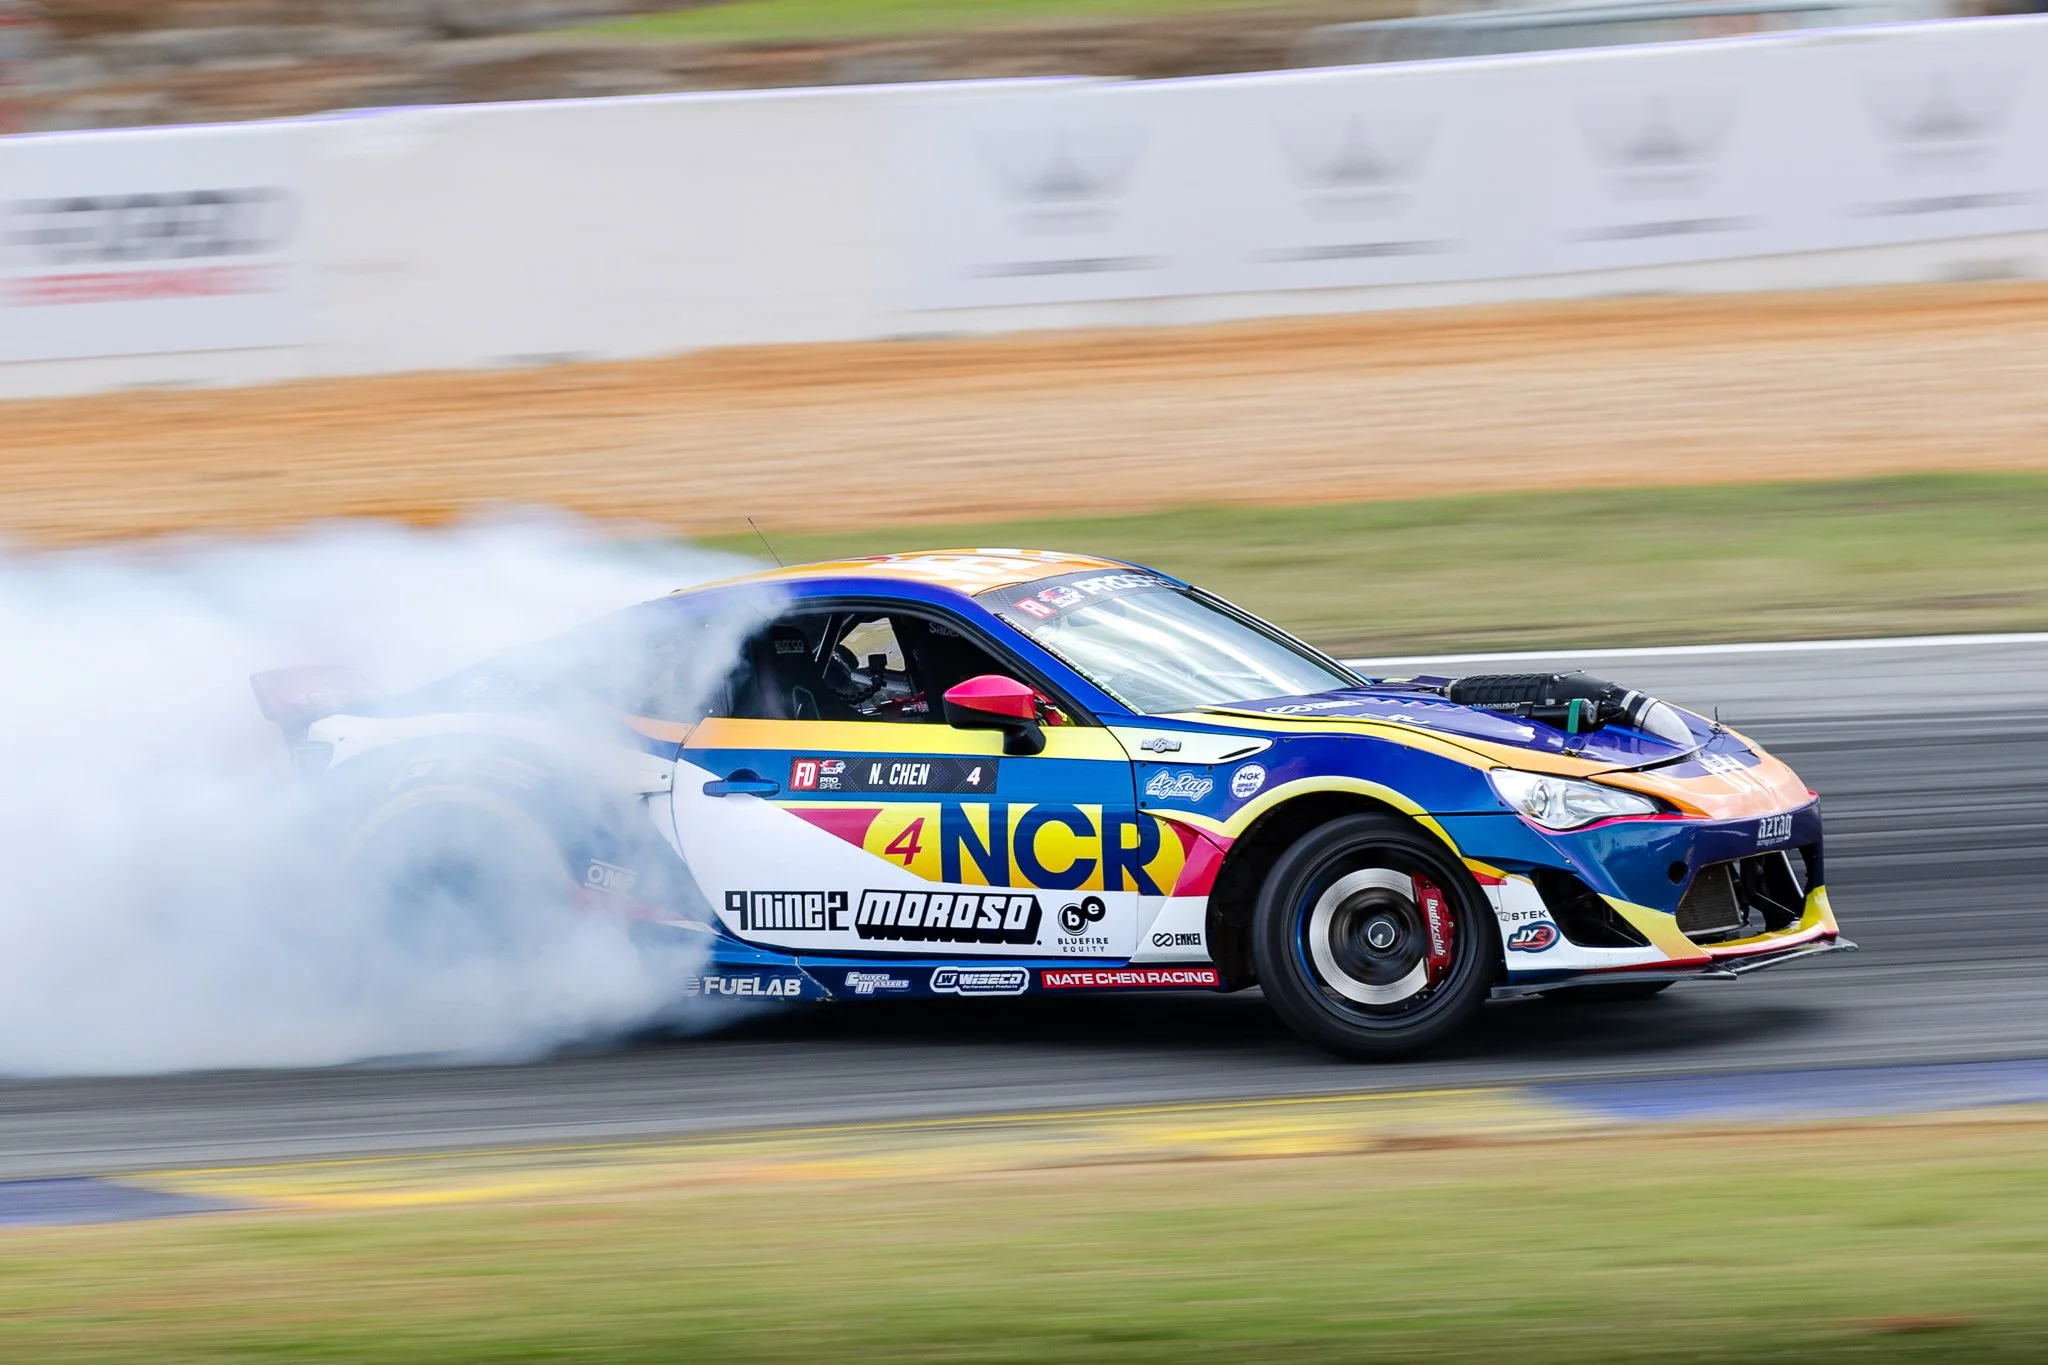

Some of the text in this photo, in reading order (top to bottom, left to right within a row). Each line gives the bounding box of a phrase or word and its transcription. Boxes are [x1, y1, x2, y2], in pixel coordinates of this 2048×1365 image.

[794, 762, 816, 787] FD
[869, 763, 982, 785] N. CHEN 4
[1238, 772, 1261, 781] NGK
[884, 800, 1167, 896] 4 NCR
[1511, 909, 1547, 921] STEK
[1057, 937, 1109, 945] BLUEFIRE
[1175, 933, 1201, 946] ENKEI
[703, 976, 801, 996] FUELAB
[1046, 972, 1215, 986] NATE CHEN RACING
